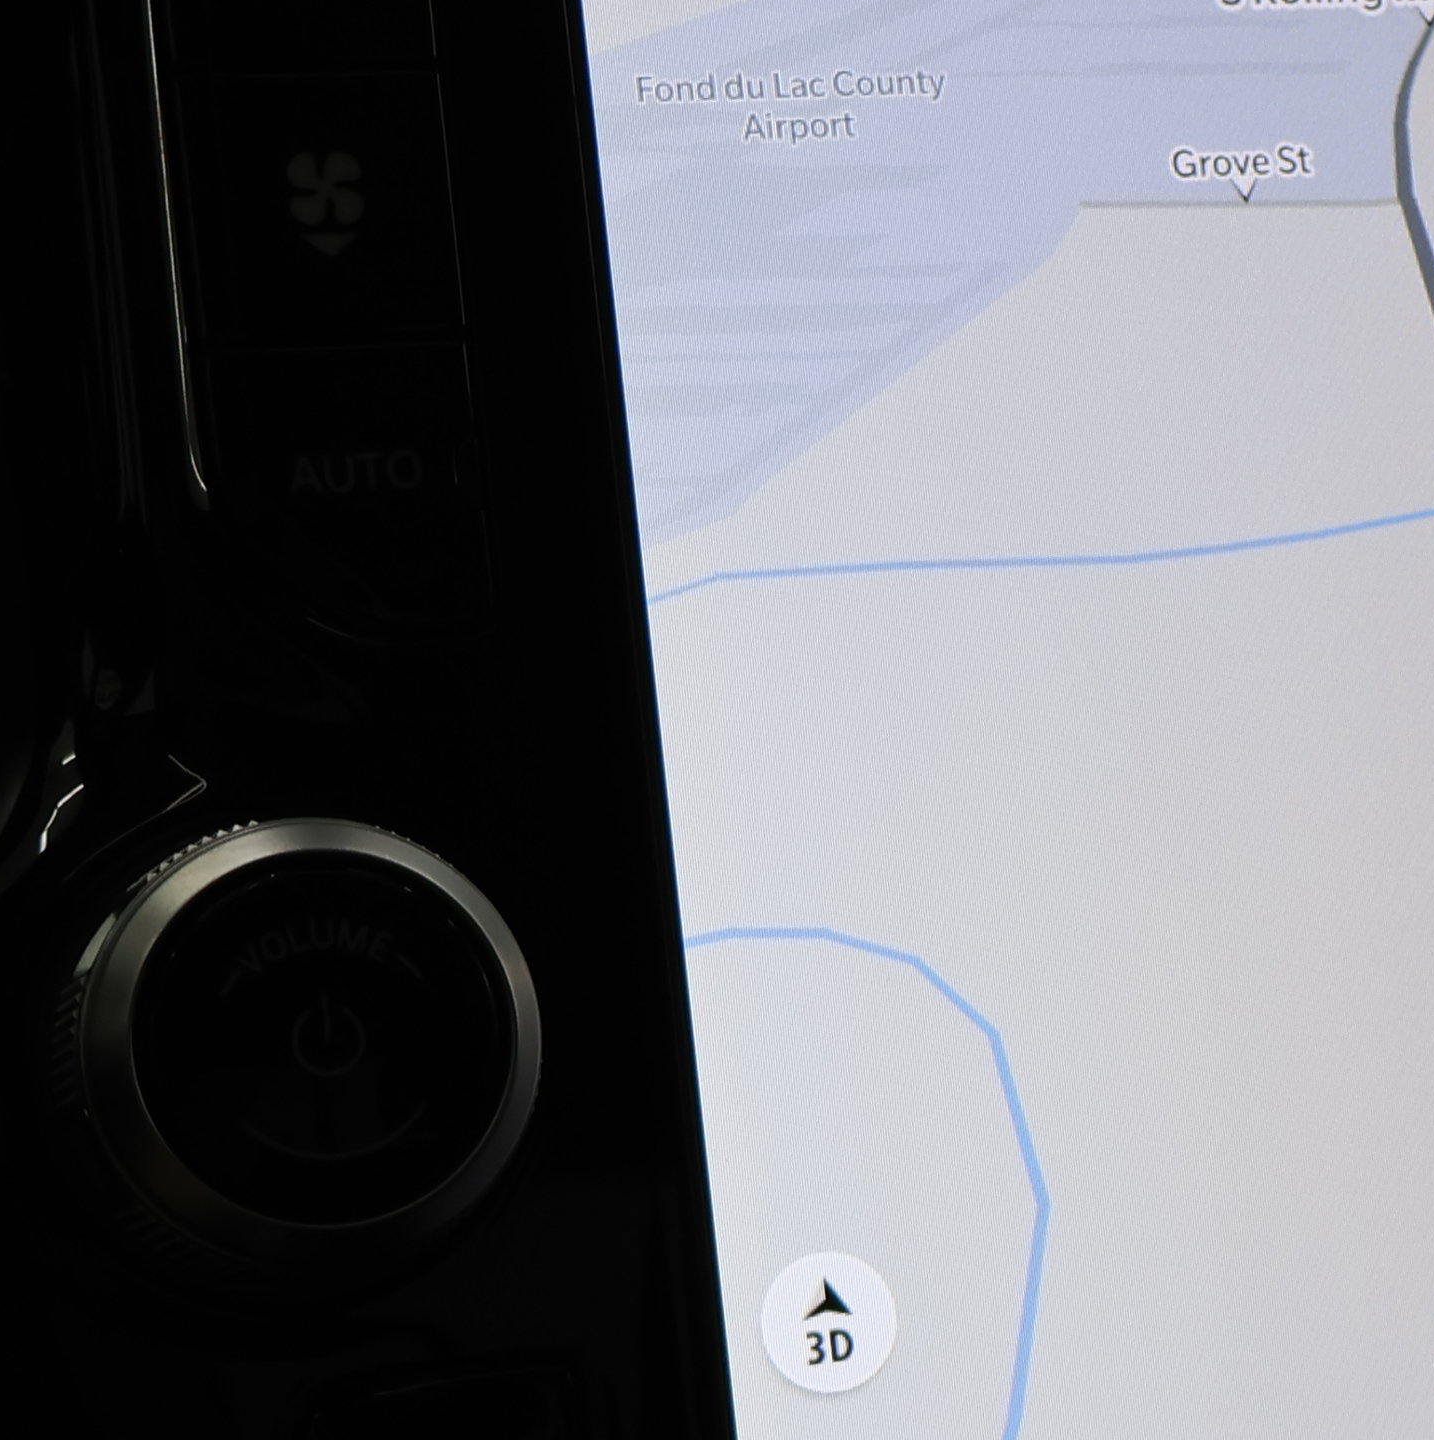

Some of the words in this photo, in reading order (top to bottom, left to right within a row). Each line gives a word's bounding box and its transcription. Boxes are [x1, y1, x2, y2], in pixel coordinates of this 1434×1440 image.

[636, 73, 716, 102] Fond
[724, 73, 764, 100] du
[773, 72, 825, 99] Lac
[832, 70, 945, 101] County
[744, 113, 854, 145] Airport
[1172, 149, 1269, 178] Grove
[1277, 145, 1310, 175] St
[291, 449, 423, 493] AUTO
[234, 918, 398, 976] VOLUME
[806, 1329, 854, 1366] 3D
